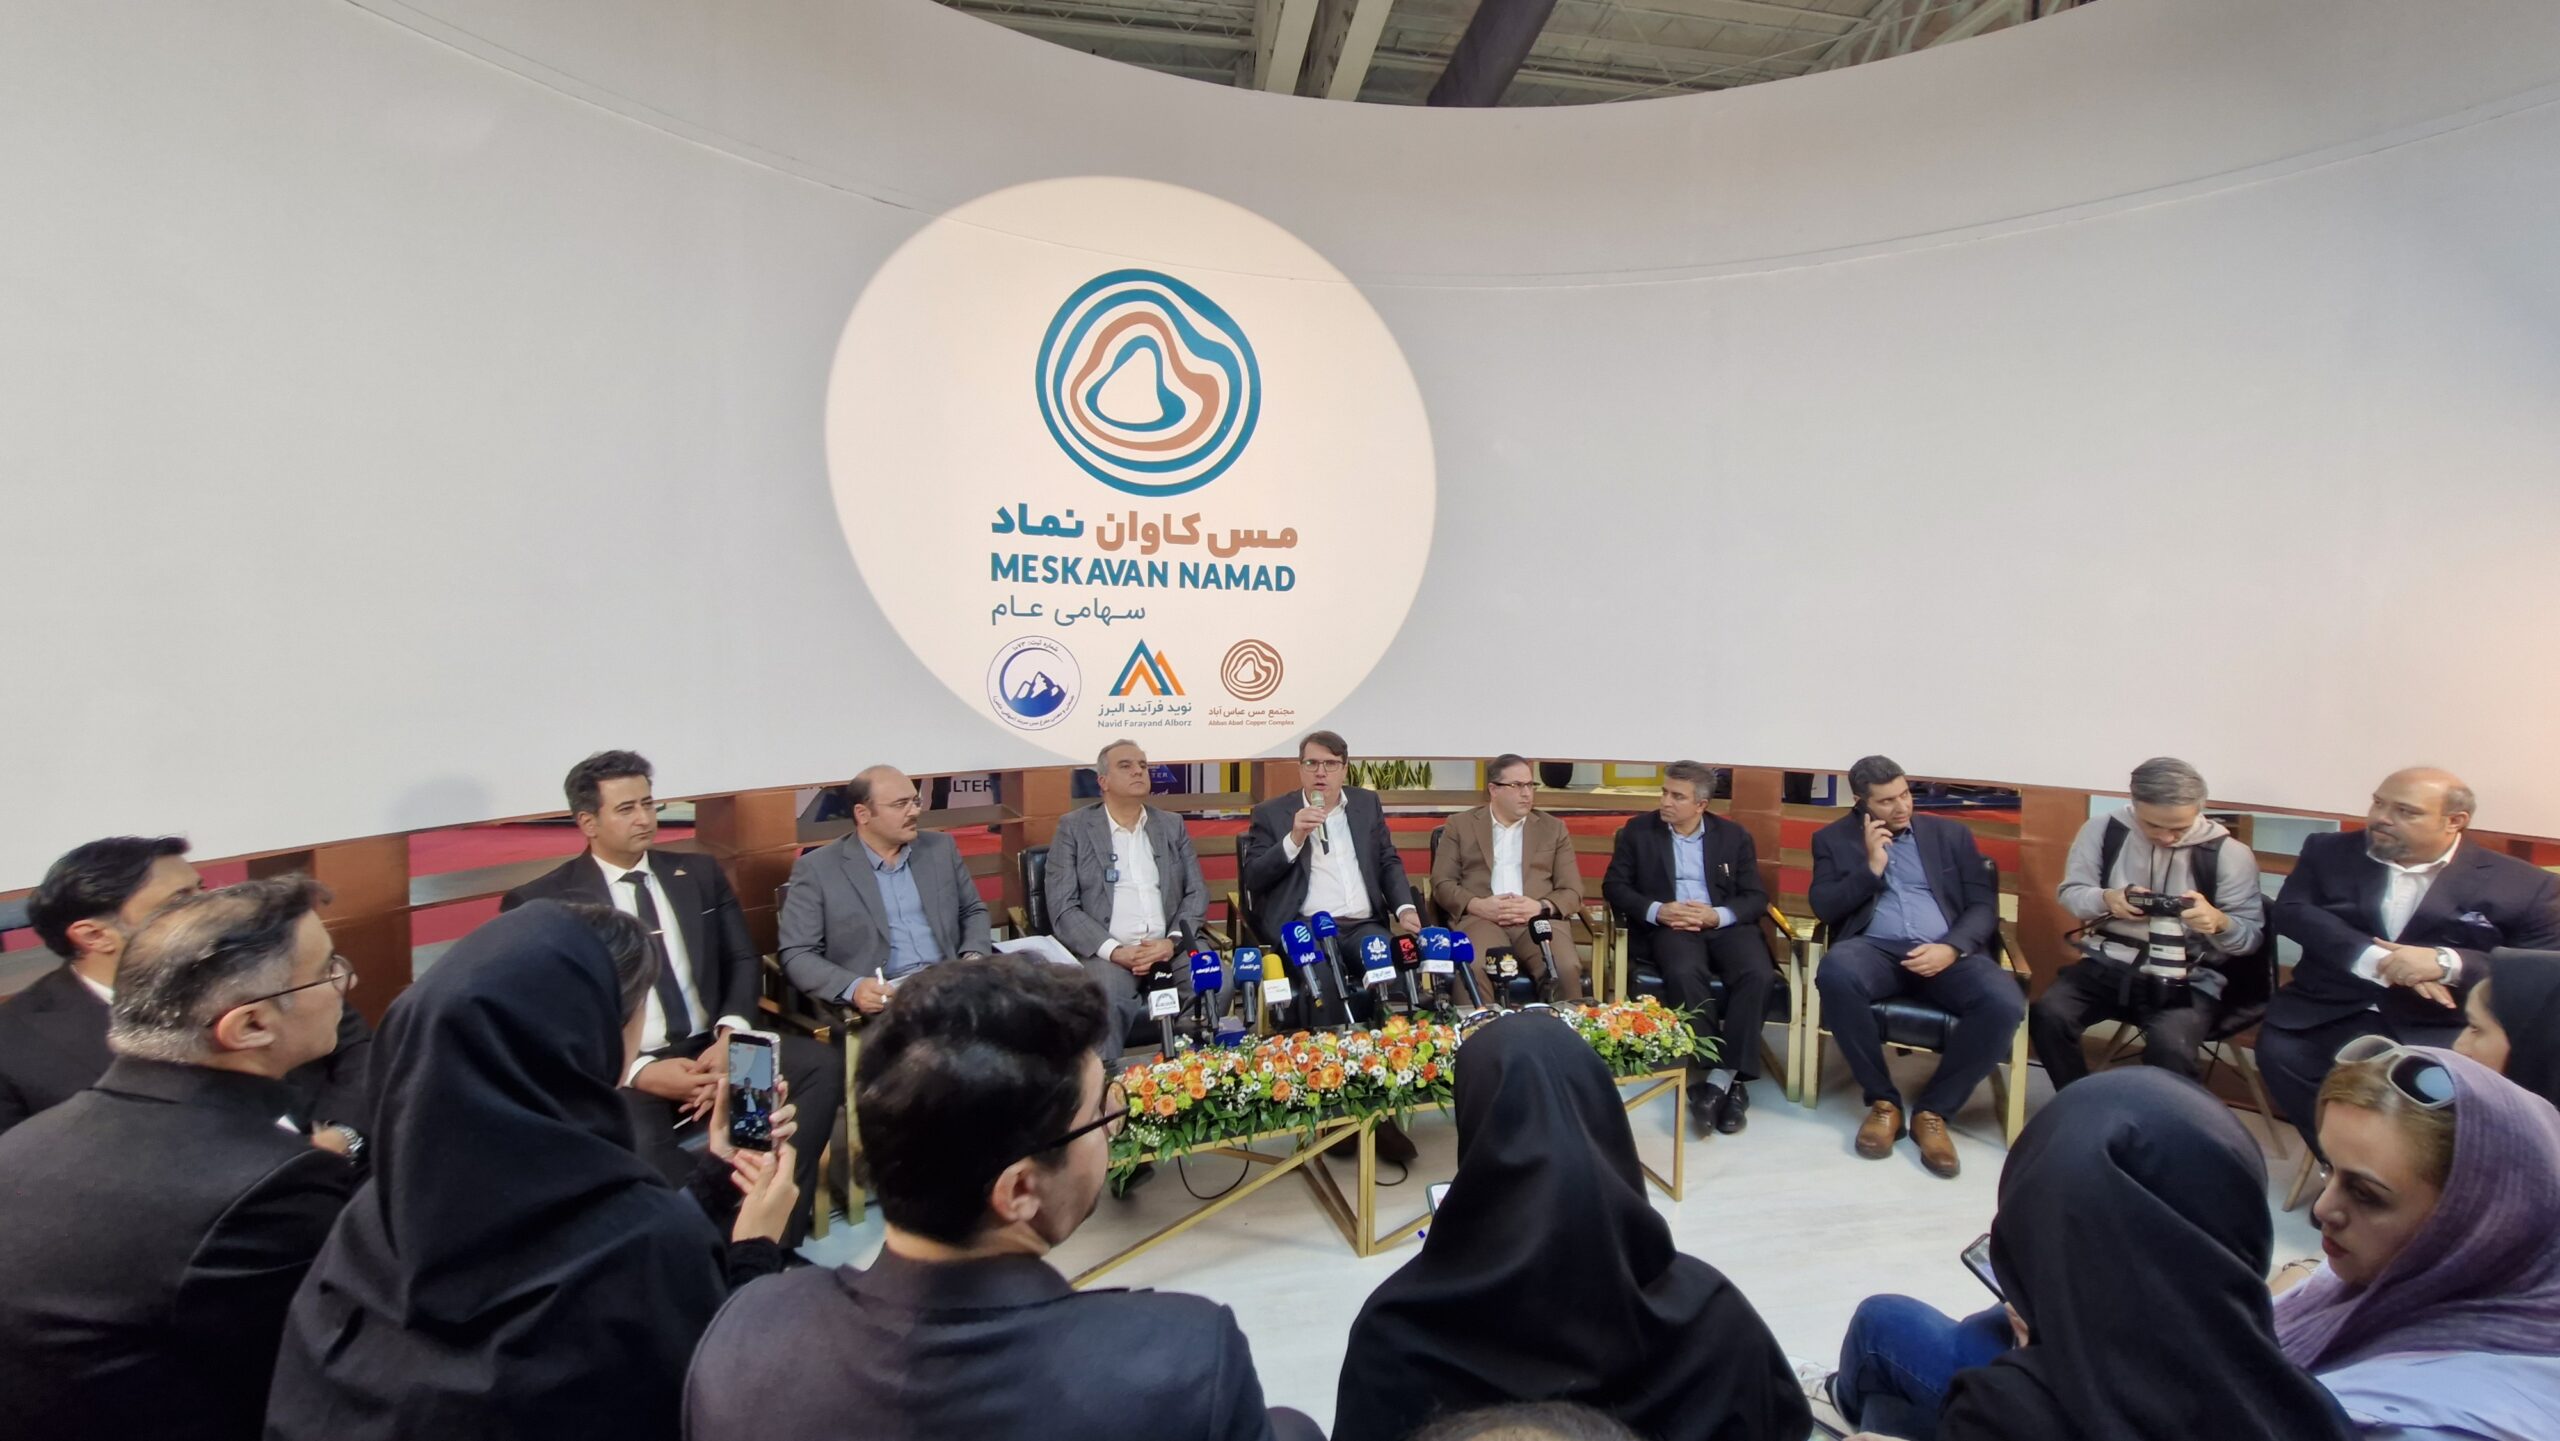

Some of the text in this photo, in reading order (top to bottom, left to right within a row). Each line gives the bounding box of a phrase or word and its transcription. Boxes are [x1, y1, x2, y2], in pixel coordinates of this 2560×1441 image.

[991, 503, 1298, 558] مس کاوان نماد
[991, 552, 1295, 592] MESKAVAN NAMAD
[992, 594, 1146, 626] سهامی عام
[1098, 699, 1192, 717] نوید فرآیند البرز
[1208, 705, 1295, 718] مجتمع مس عباس آباد
[1097, 718, 1192, 729] Navid Farayand Alborz
[1245, 719, 1267, 727] Copper
[1268, 719, 1294, 727] Complex
